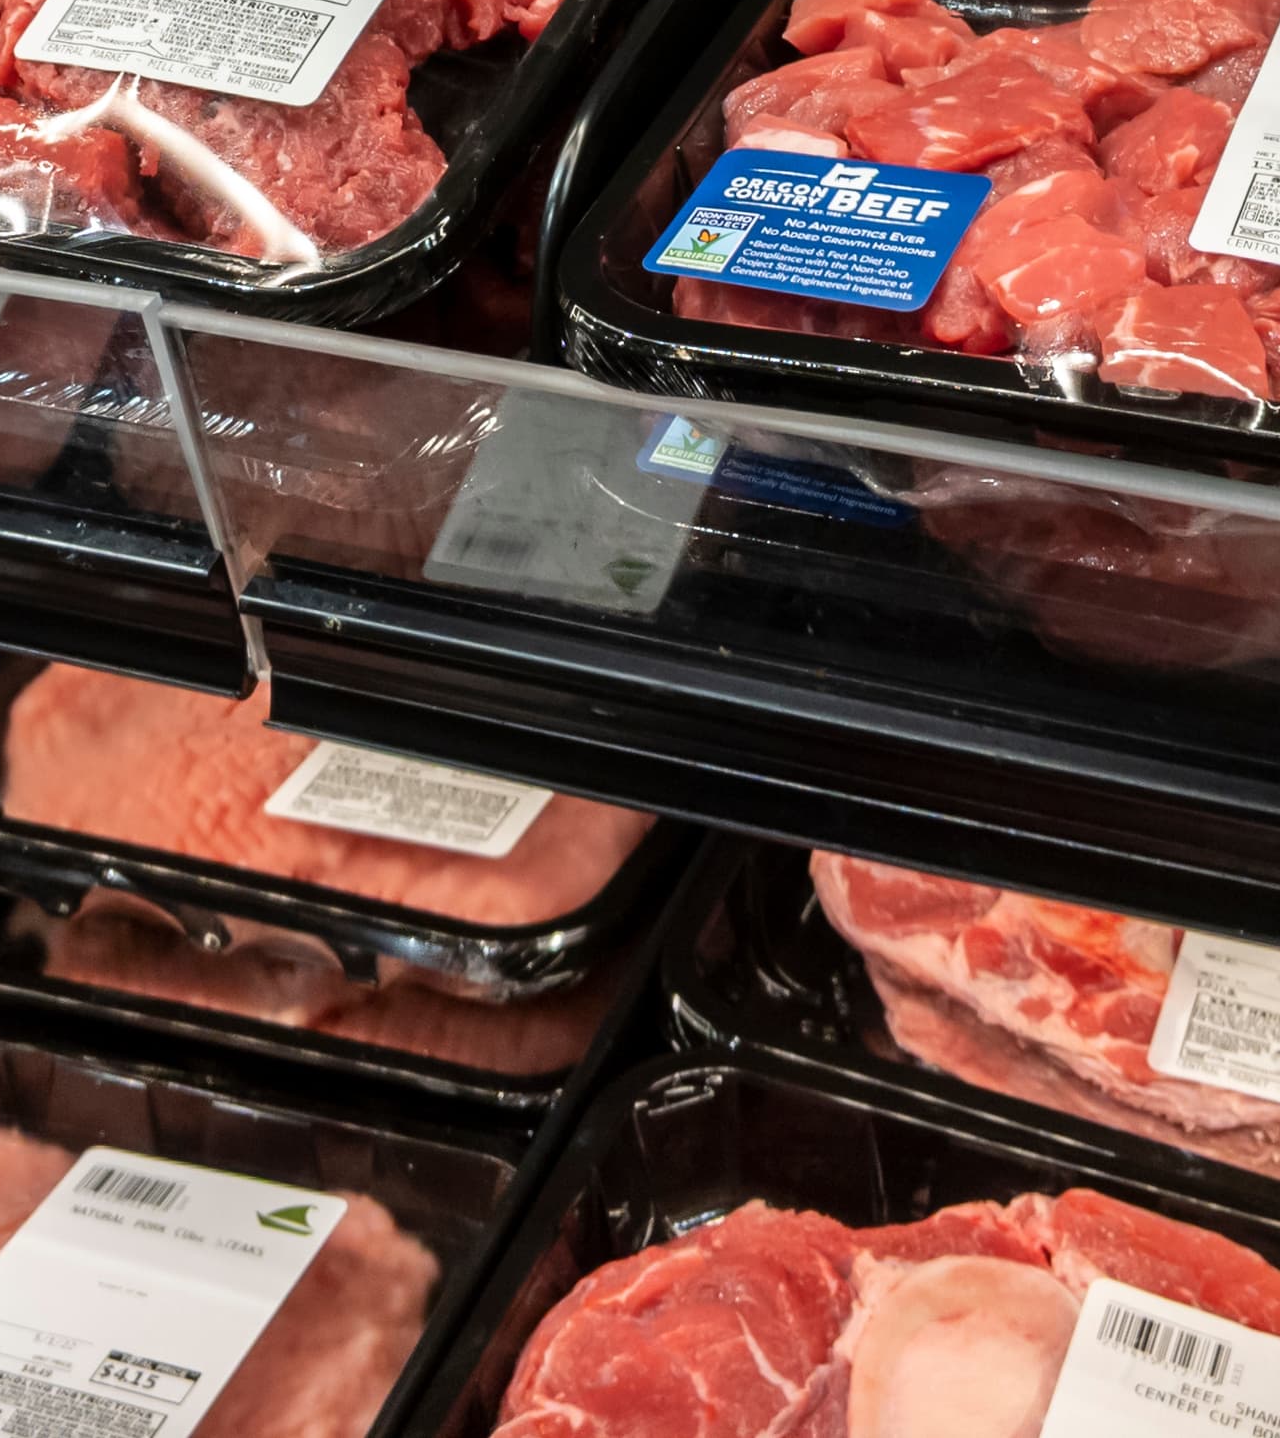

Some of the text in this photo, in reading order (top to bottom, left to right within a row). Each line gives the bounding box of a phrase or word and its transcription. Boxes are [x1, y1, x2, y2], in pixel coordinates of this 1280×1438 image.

[91, 48, 284, 94] MARKET MILL WA 98012
[1256, 150, 1276, 158] NET
[730, 176, 829, 199] OREGON
[696, 210, 752, 223] NON-GMO
[723, 187, 951, 223] COUNTRY BEEF
[692, 218, 748, 230] PROJECT
[669, 249, 725, 262] VERIFIED
[742, 248, 804, 265] Compliance
[805, 257, 829, 268] with
[830, 261, 849, 271] the
[851, 263, 909, 279] Non-GMO
[779, 244, 814, 256] Raised
[815, 249, 825, 257] &
[827, 250, 847, 260] Fed
[848, 253, 857, 262] A
[860, 255, 883, 266] Diet
[885, 258, 896, 267] in
[730, 265, 913, 301] Genetically Engineered Ingredients
[736, 257, 773, 270] Project
[775, 262, 822, 277] Standard
[824, 270, 840, 279] for
[841, 273, 897, 289] Avoidance
[899, 280, 913, 290] of
[660, 446, 715, 464] VERIFIED
[71, 1204, 124, 1225] NATURAL
[98, 1366, 159, 1391] $4.15
[1180, 1382, 1225, 1406] BEEF
[1134, 1383, 1242, 1429] CENTER CUT
